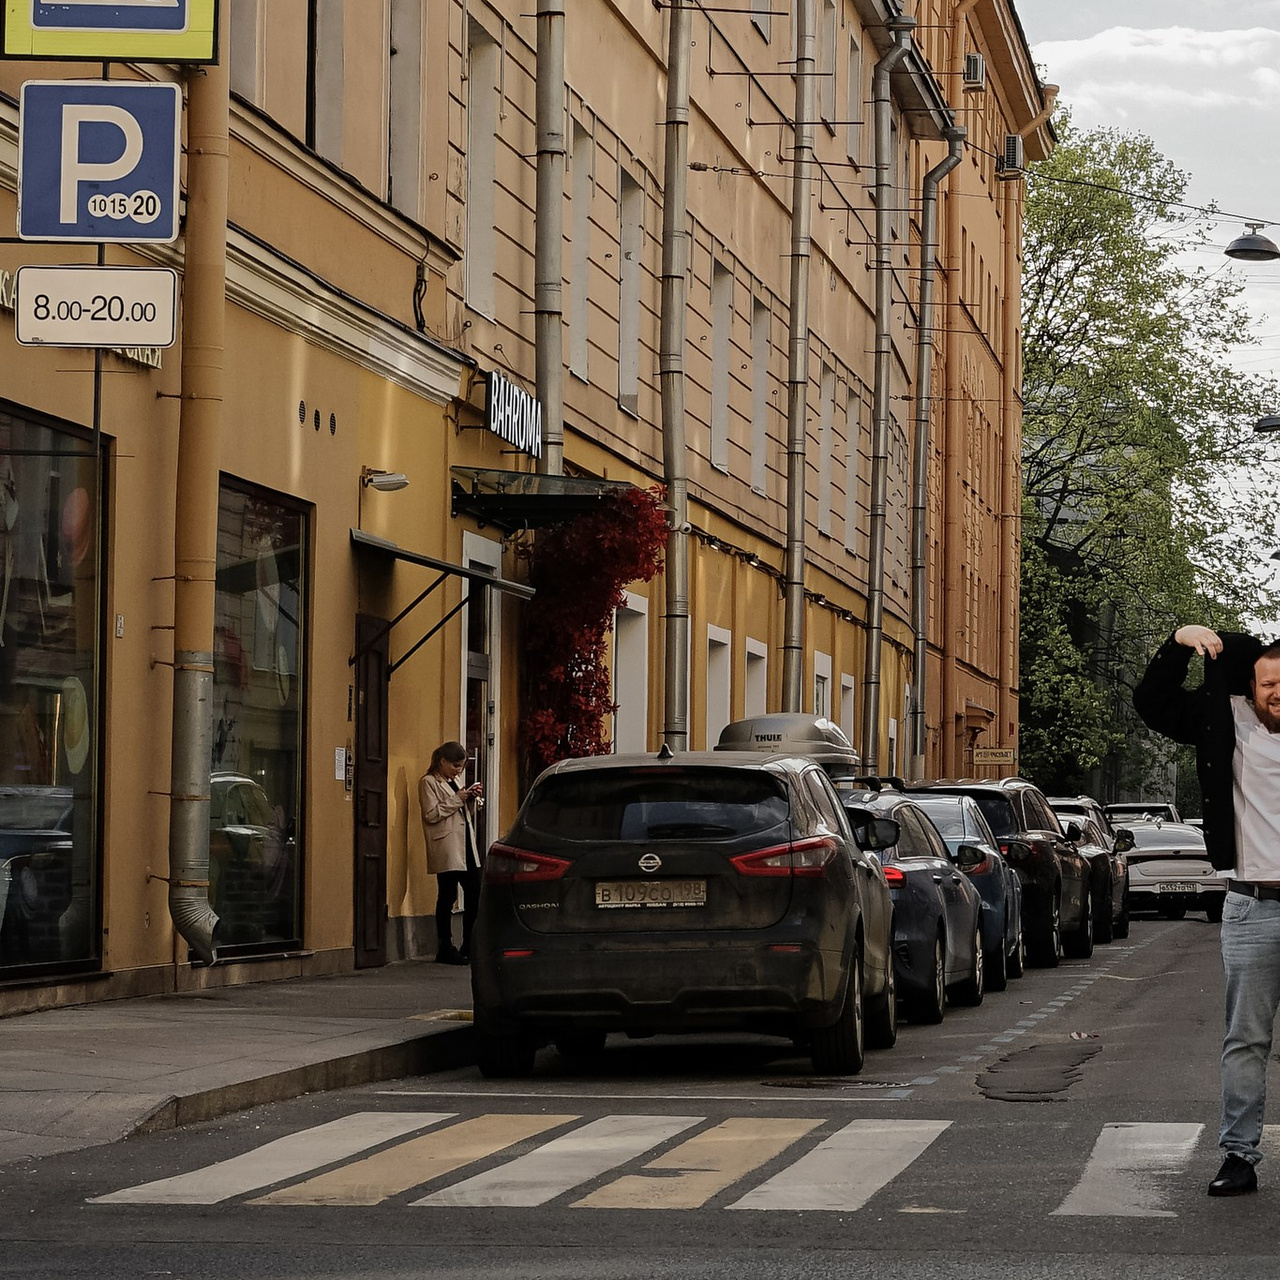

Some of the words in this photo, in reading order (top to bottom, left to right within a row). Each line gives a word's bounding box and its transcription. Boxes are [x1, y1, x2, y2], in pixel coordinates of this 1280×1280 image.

[60, 104, 144, 224] P
[91, 198, 107, 212] 10
[110, 198, 127, 214] 15
[133, 195, 157, 216] 20
[33, 294, 157, 322] 8.00-20.00
[490, 371, 542, 460] BAHROMA
[754, 734, 782, 742] THULE
